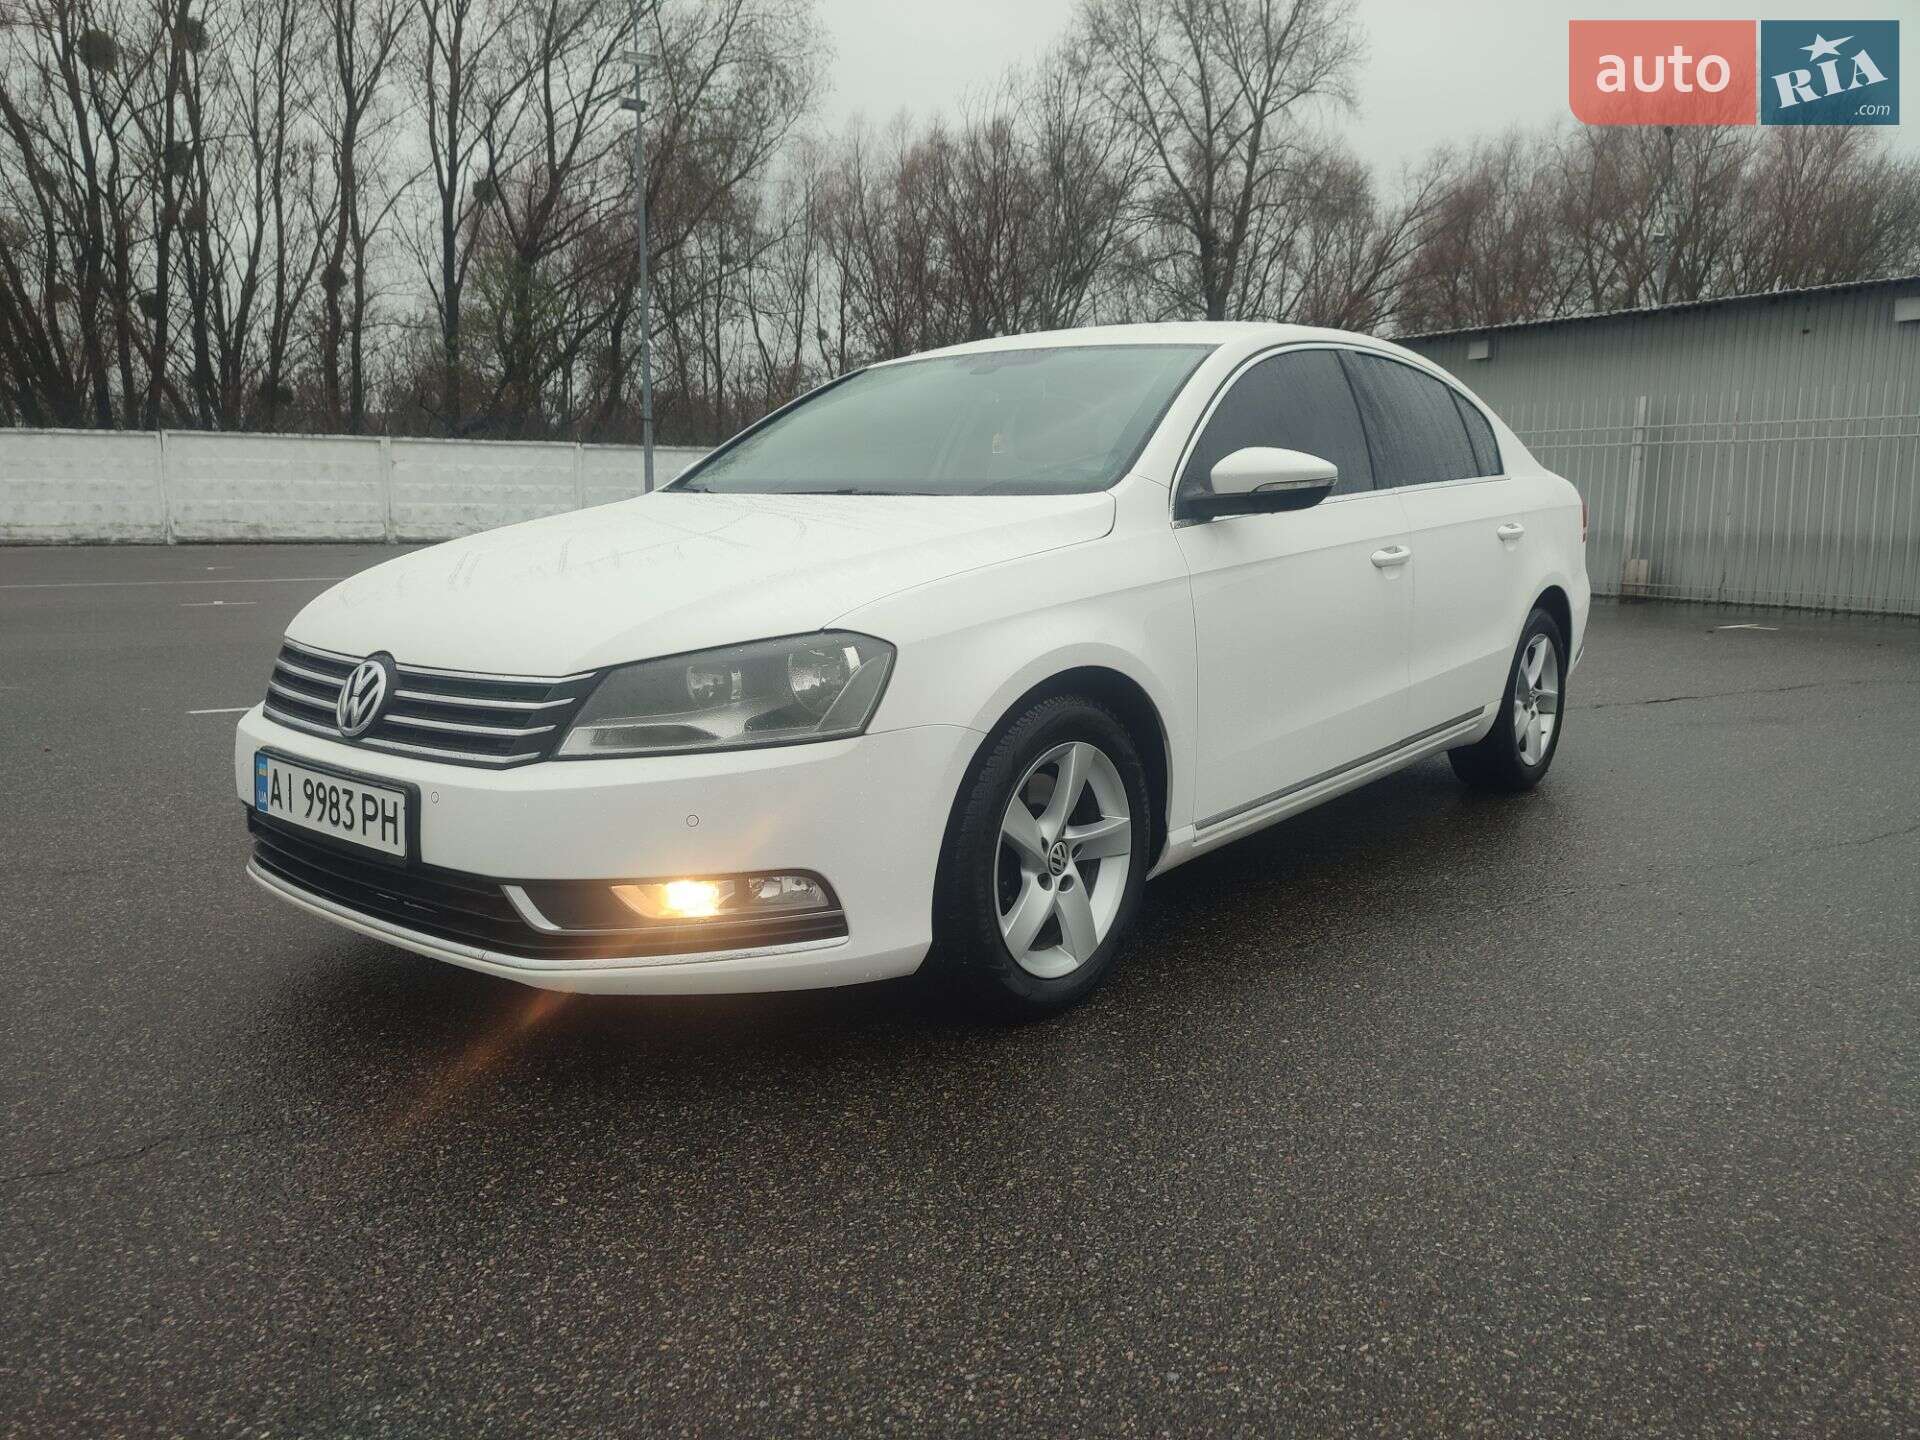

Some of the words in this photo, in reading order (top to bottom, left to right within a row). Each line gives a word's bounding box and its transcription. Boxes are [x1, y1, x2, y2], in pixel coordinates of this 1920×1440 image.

[270, 768, 293, 813] AI
[303, 778, 355, 831] 9983
[361, 792, 398, 845] PH
